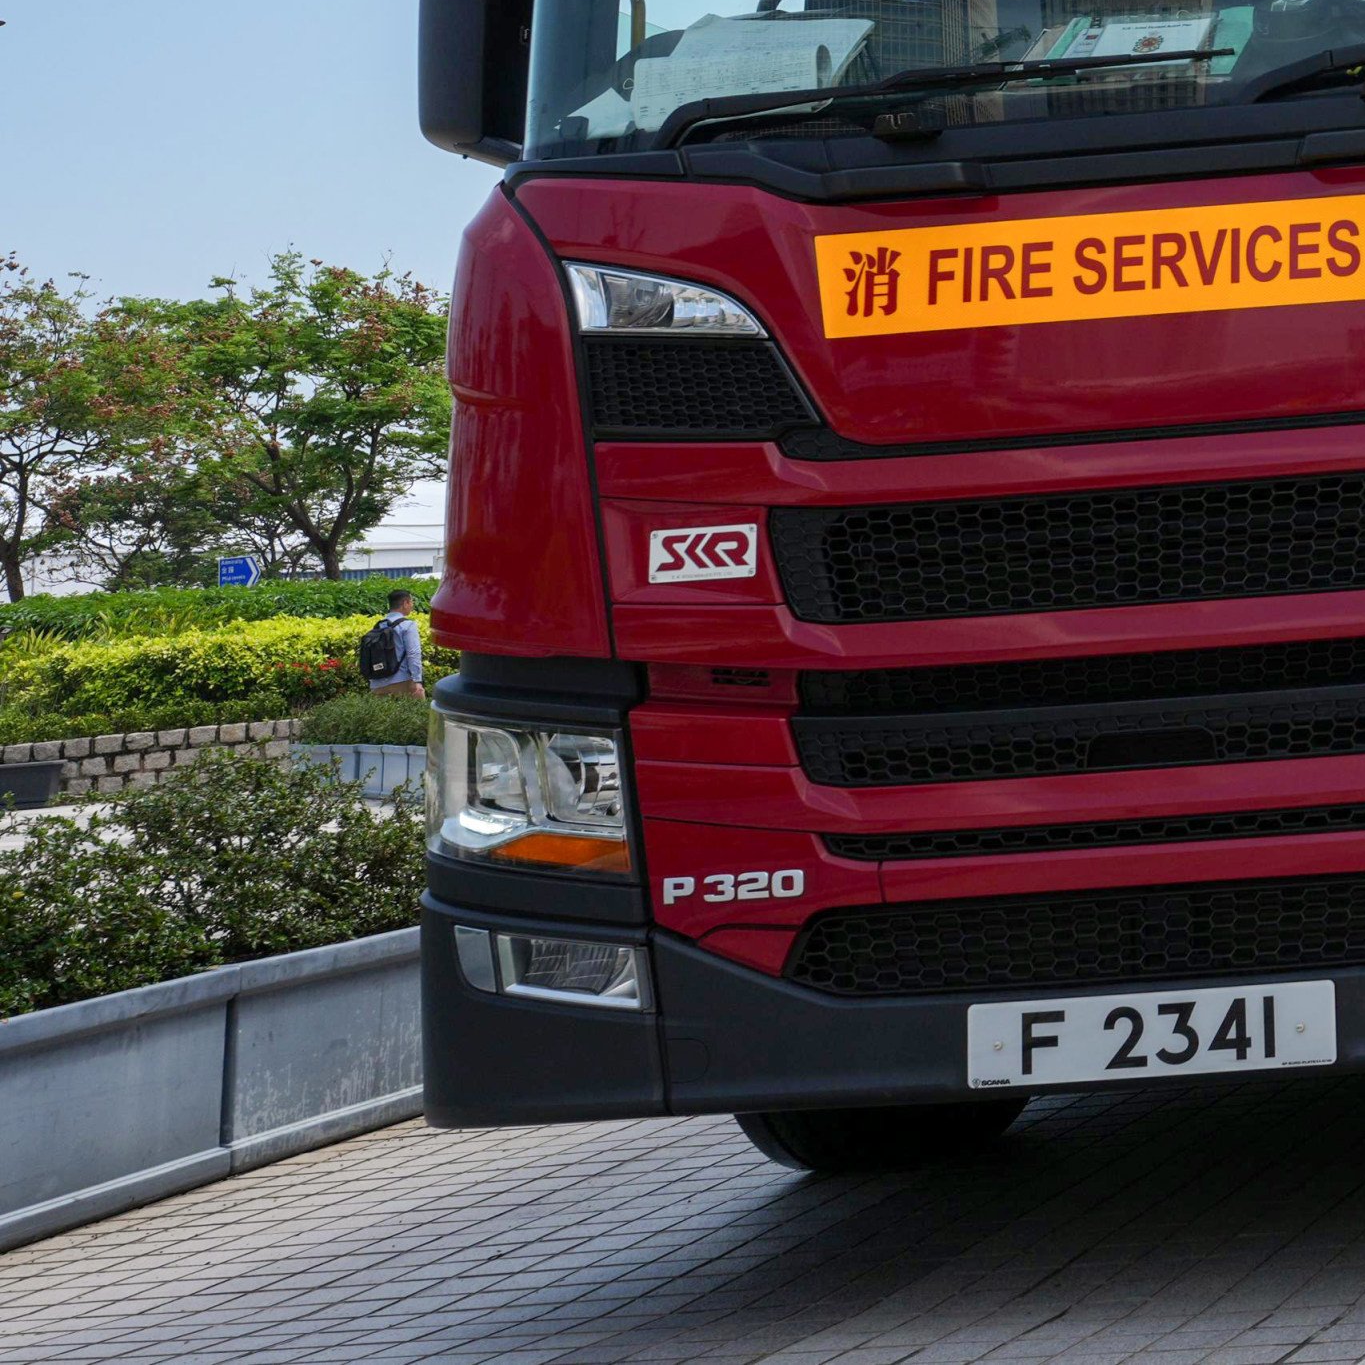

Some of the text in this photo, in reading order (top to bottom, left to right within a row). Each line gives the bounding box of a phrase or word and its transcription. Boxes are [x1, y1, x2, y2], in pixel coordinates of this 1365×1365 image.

[842, 246, 902, 318] 消
[927, 241, 1054, 305] FIRE
[1073, 219, 1361, 295] SERVICES
[656, 530, 750, 572] SKR
[663, 869, 804, 905] P 320
[1022, 995, 1276, 1075] F 2341
[981, 1078, 1011, 1086] SCANIA
